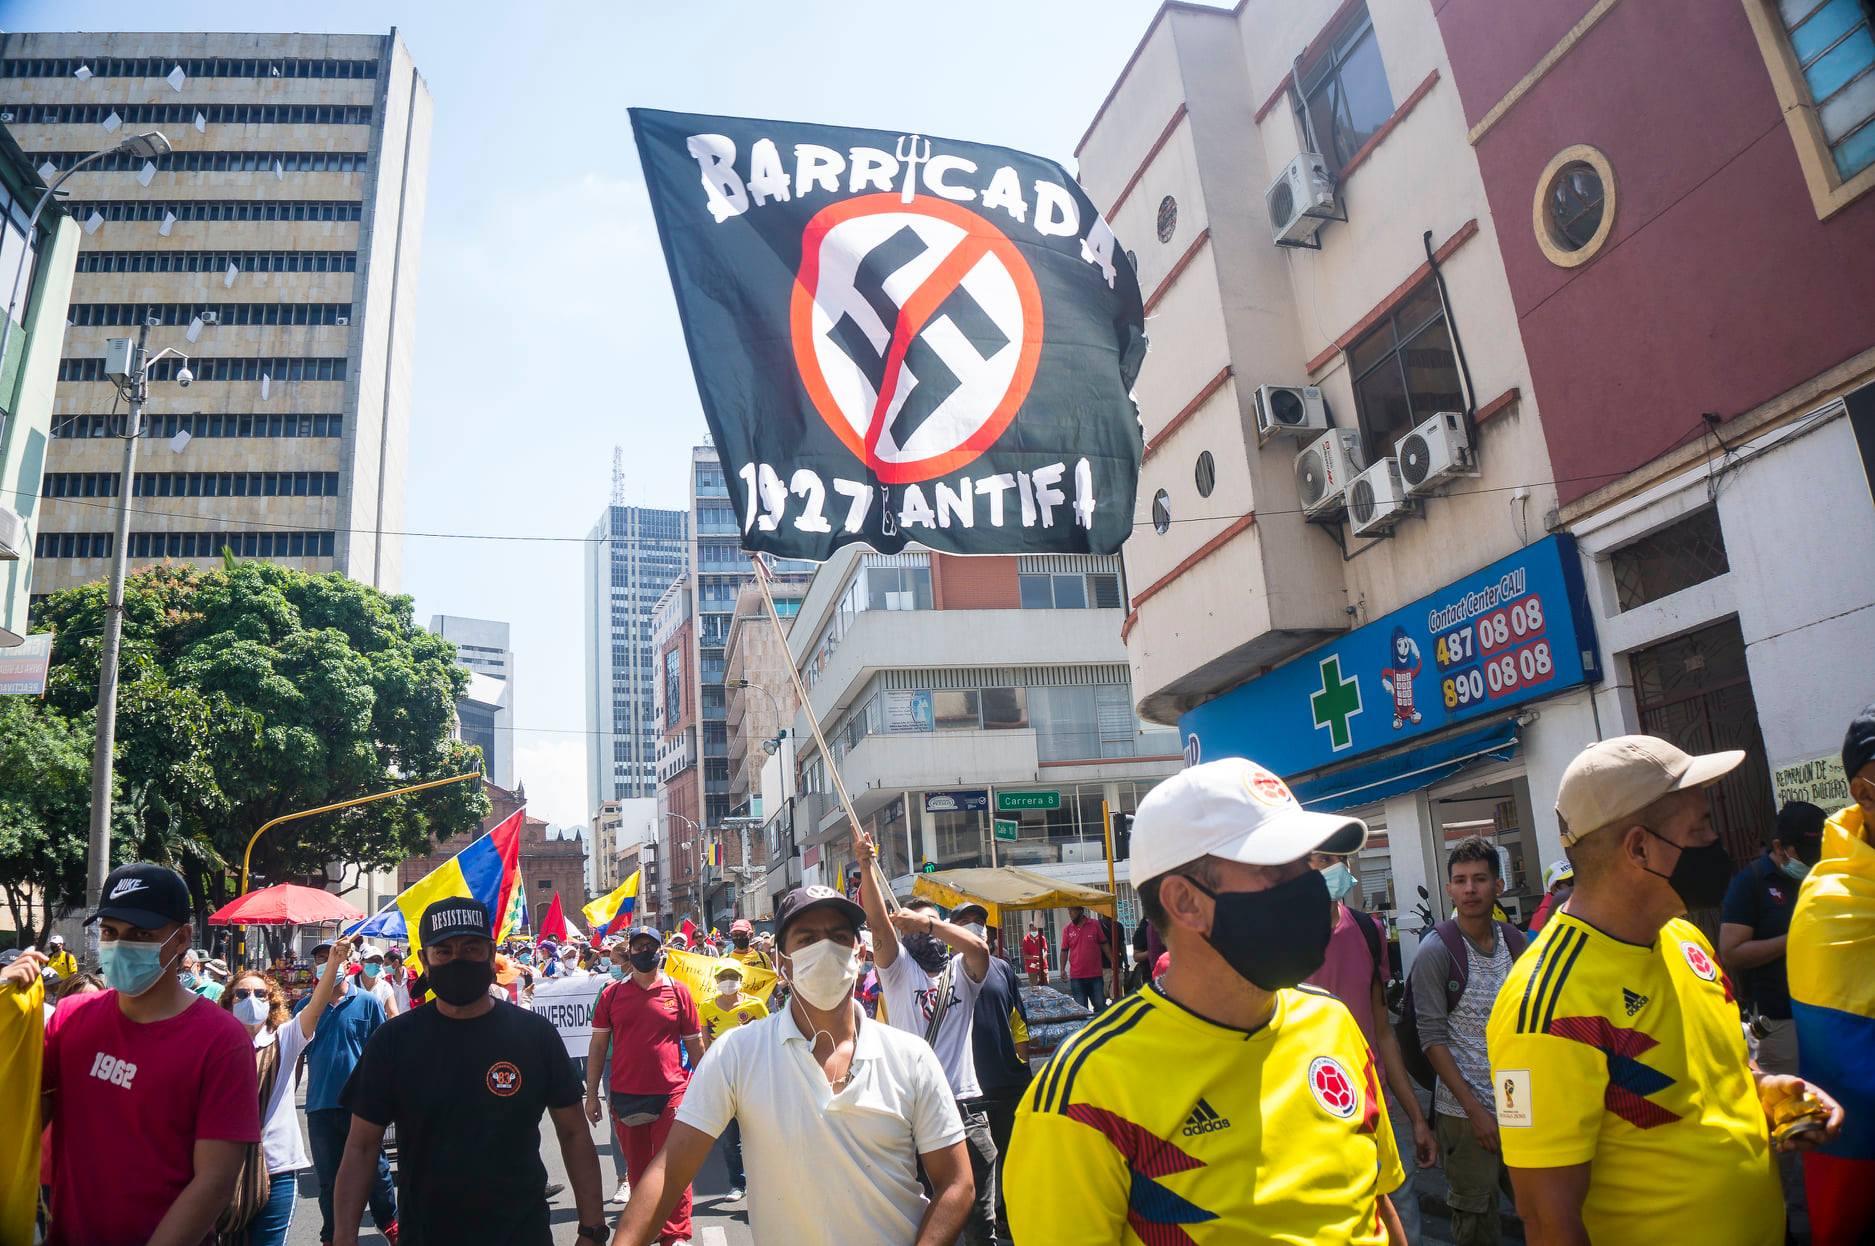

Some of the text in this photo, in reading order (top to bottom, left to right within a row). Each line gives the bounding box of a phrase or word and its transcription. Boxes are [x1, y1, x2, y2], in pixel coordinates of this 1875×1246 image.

[738, 462, 877, 536] 1927
[1429, 567, 1526, 634] Contact Center CALI
[1436, 598, 1543, 666] 487 08 08
[1443, 643, 1552, 708] 890 08 08
[1815, 760, 1827, 780] DE
[1005, 796, 1054, 806] Carrera 8
[115, 878, 142, 891] NIKE
[432, 909, 484, 931] RESISTENCIA
[89, 1051, 138, 1090] 1962
[1183, 1118, 1230, 1136] adidas
